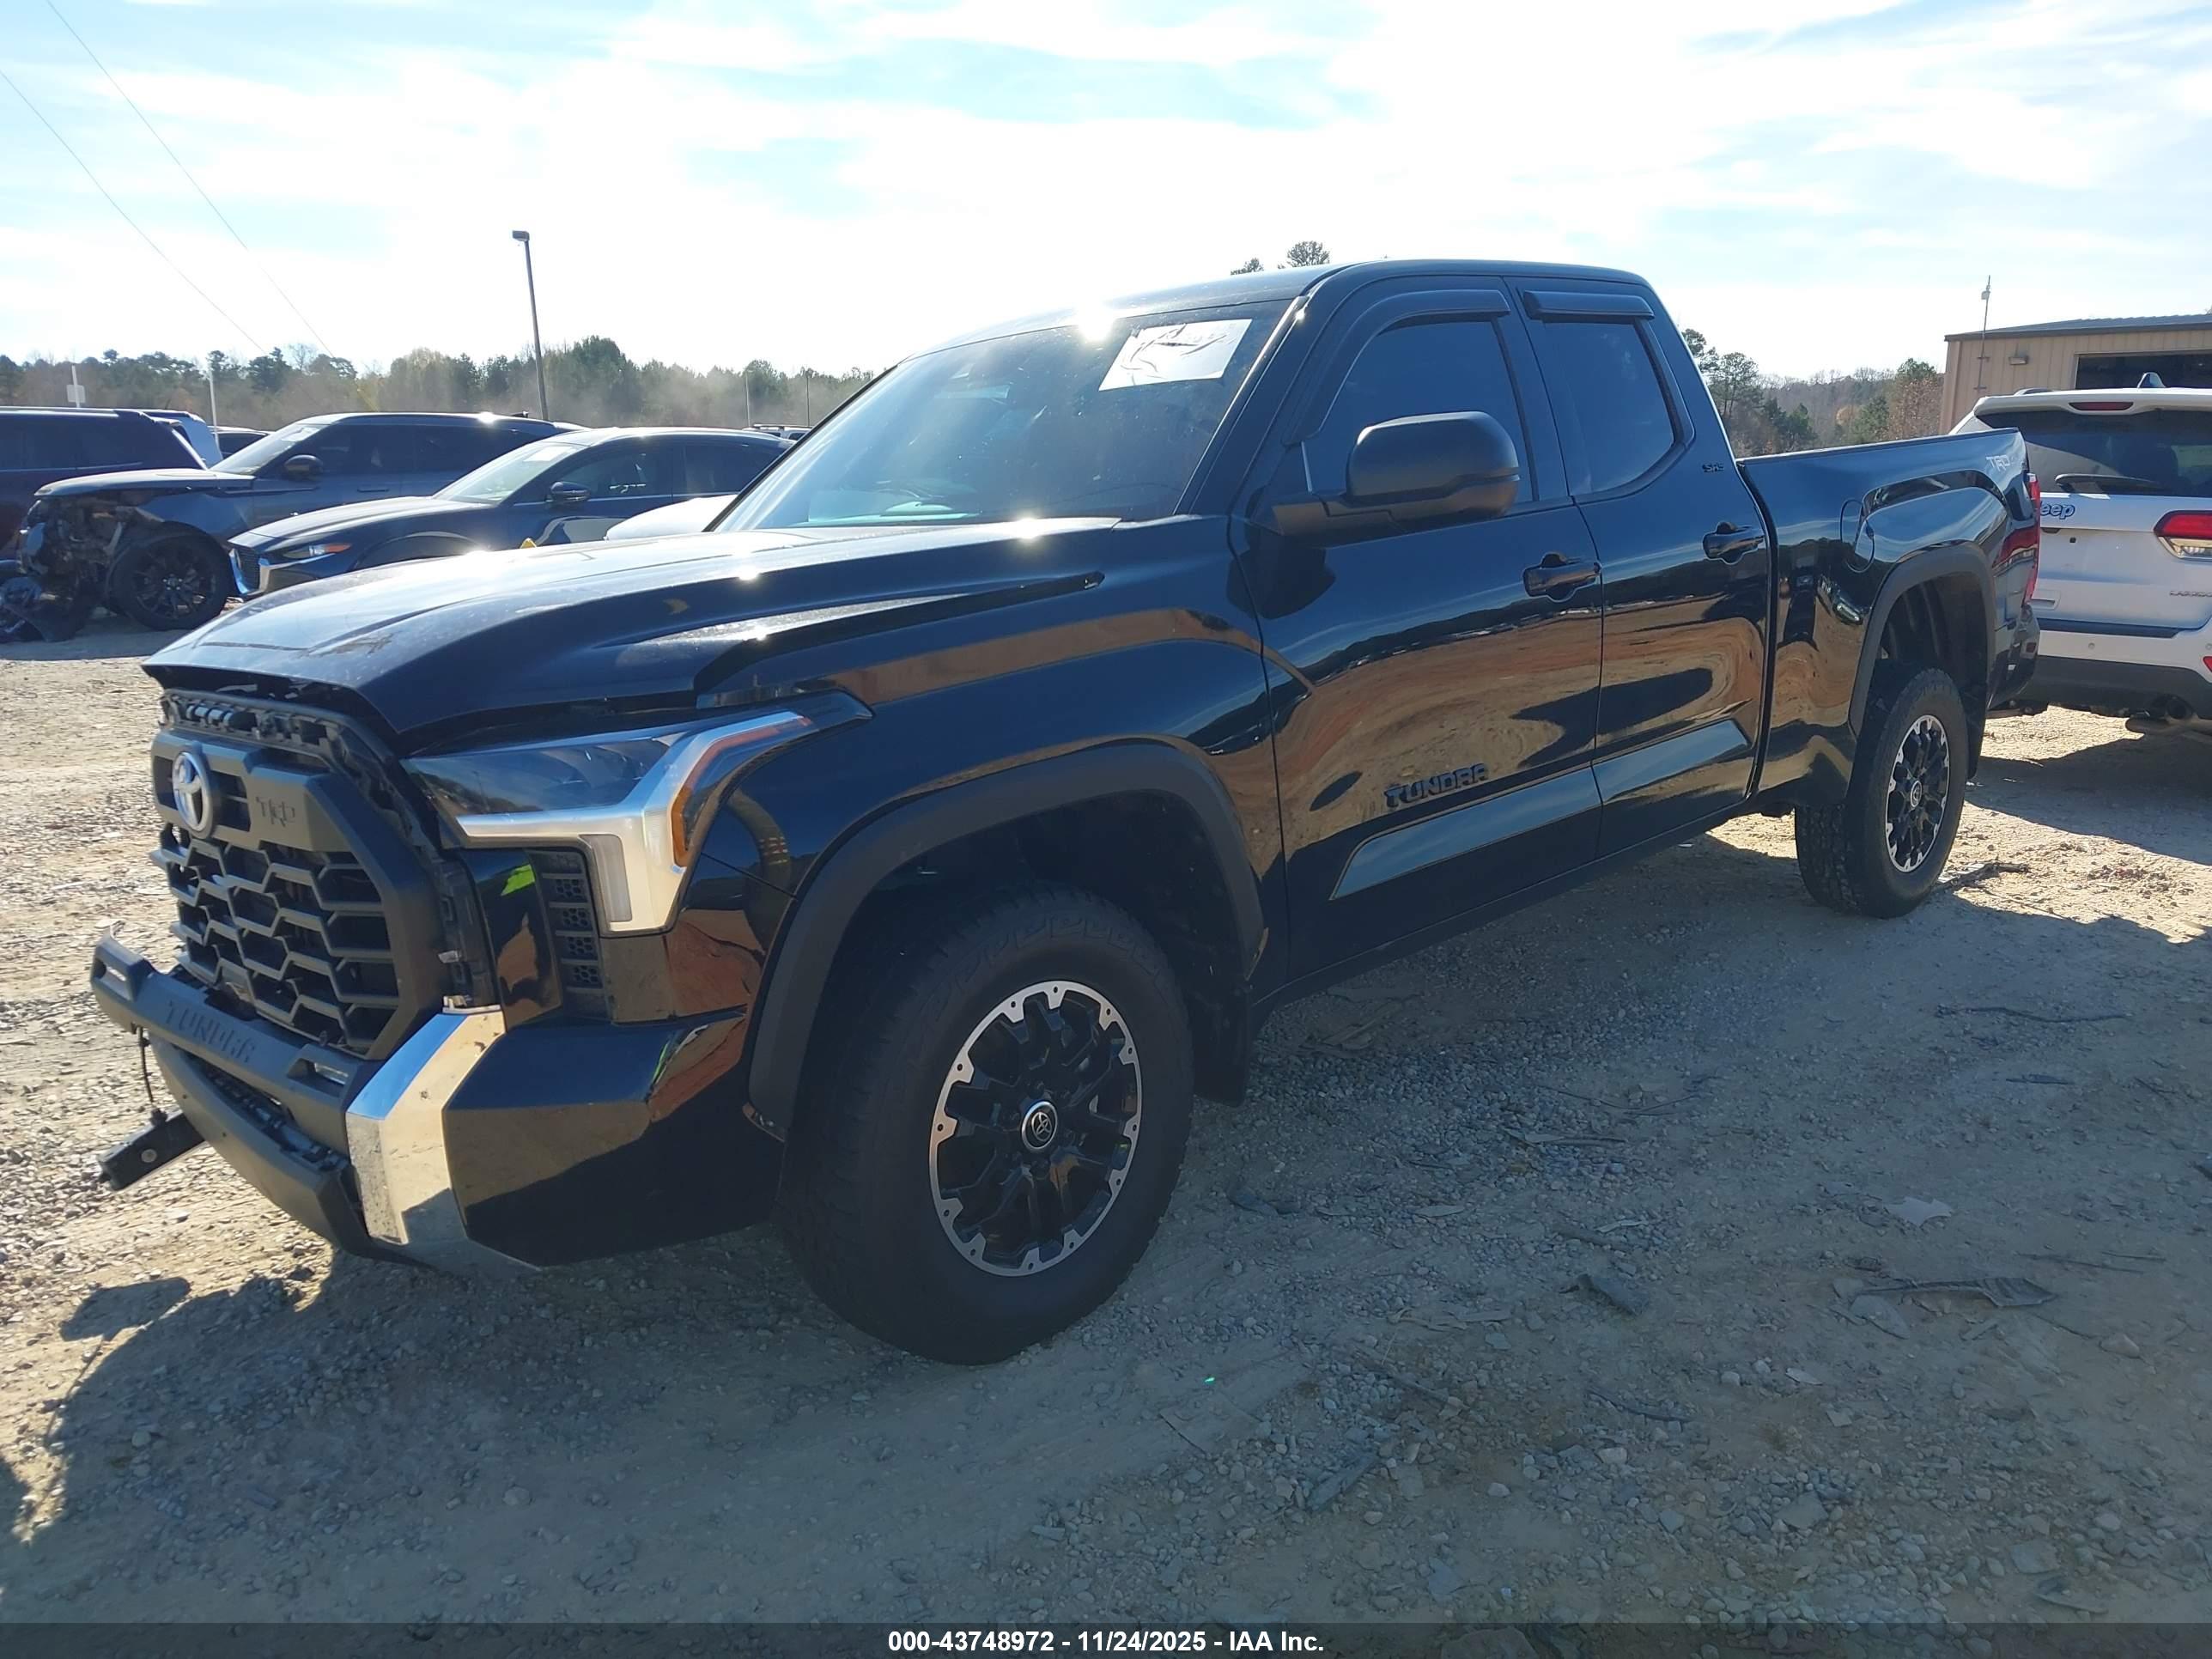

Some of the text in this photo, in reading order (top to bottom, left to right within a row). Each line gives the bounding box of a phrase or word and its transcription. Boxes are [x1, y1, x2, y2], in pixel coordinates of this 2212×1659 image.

[1985, 454, 2010, 471] TRD
[2040, 501, 2075, 520] eep
[1383, 763, 1490, 808] TUNDRA
[255, 796, 295, 828] TRD
[165, 1000, 257, 1063] TUNDRA
